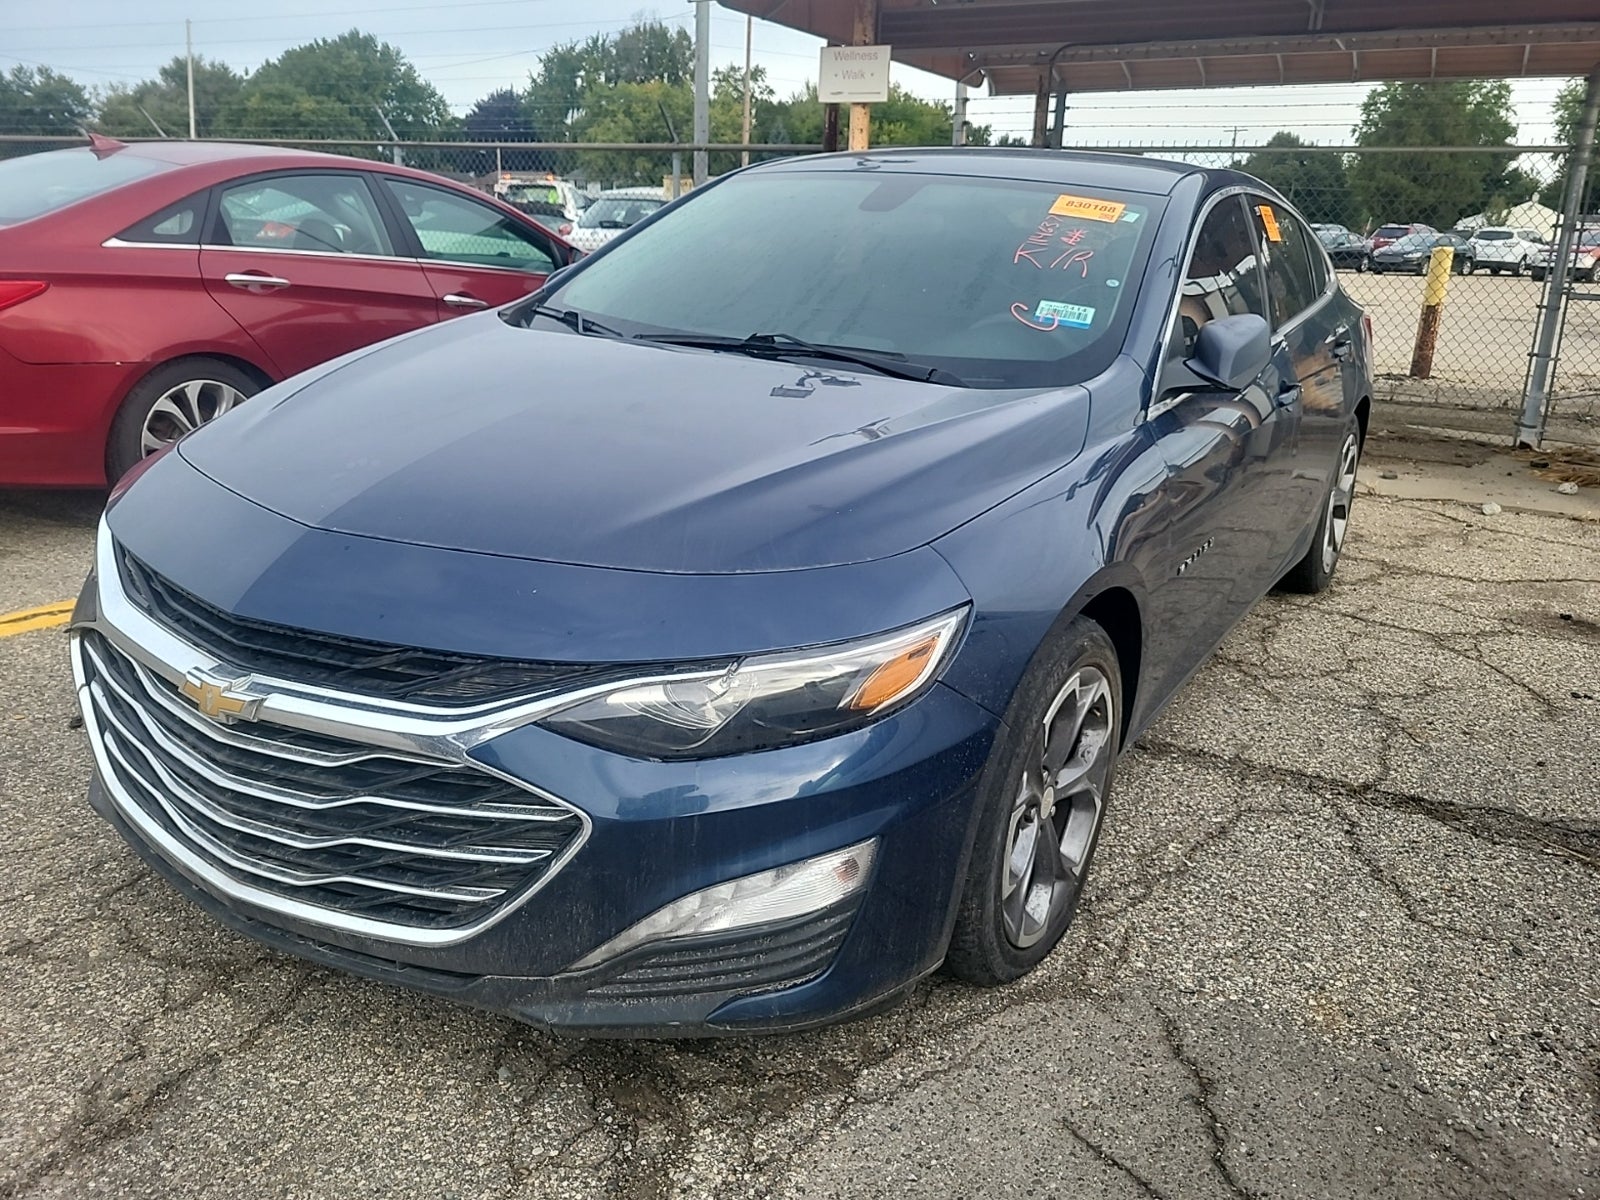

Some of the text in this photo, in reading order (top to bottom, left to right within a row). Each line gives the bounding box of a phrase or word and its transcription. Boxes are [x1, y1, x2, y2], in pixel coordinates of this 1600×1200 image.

[833, 50, 879, 62] Wellness
[841, 69, 866, 80] Walk
[1065, 200, 1117, 214] 830188
